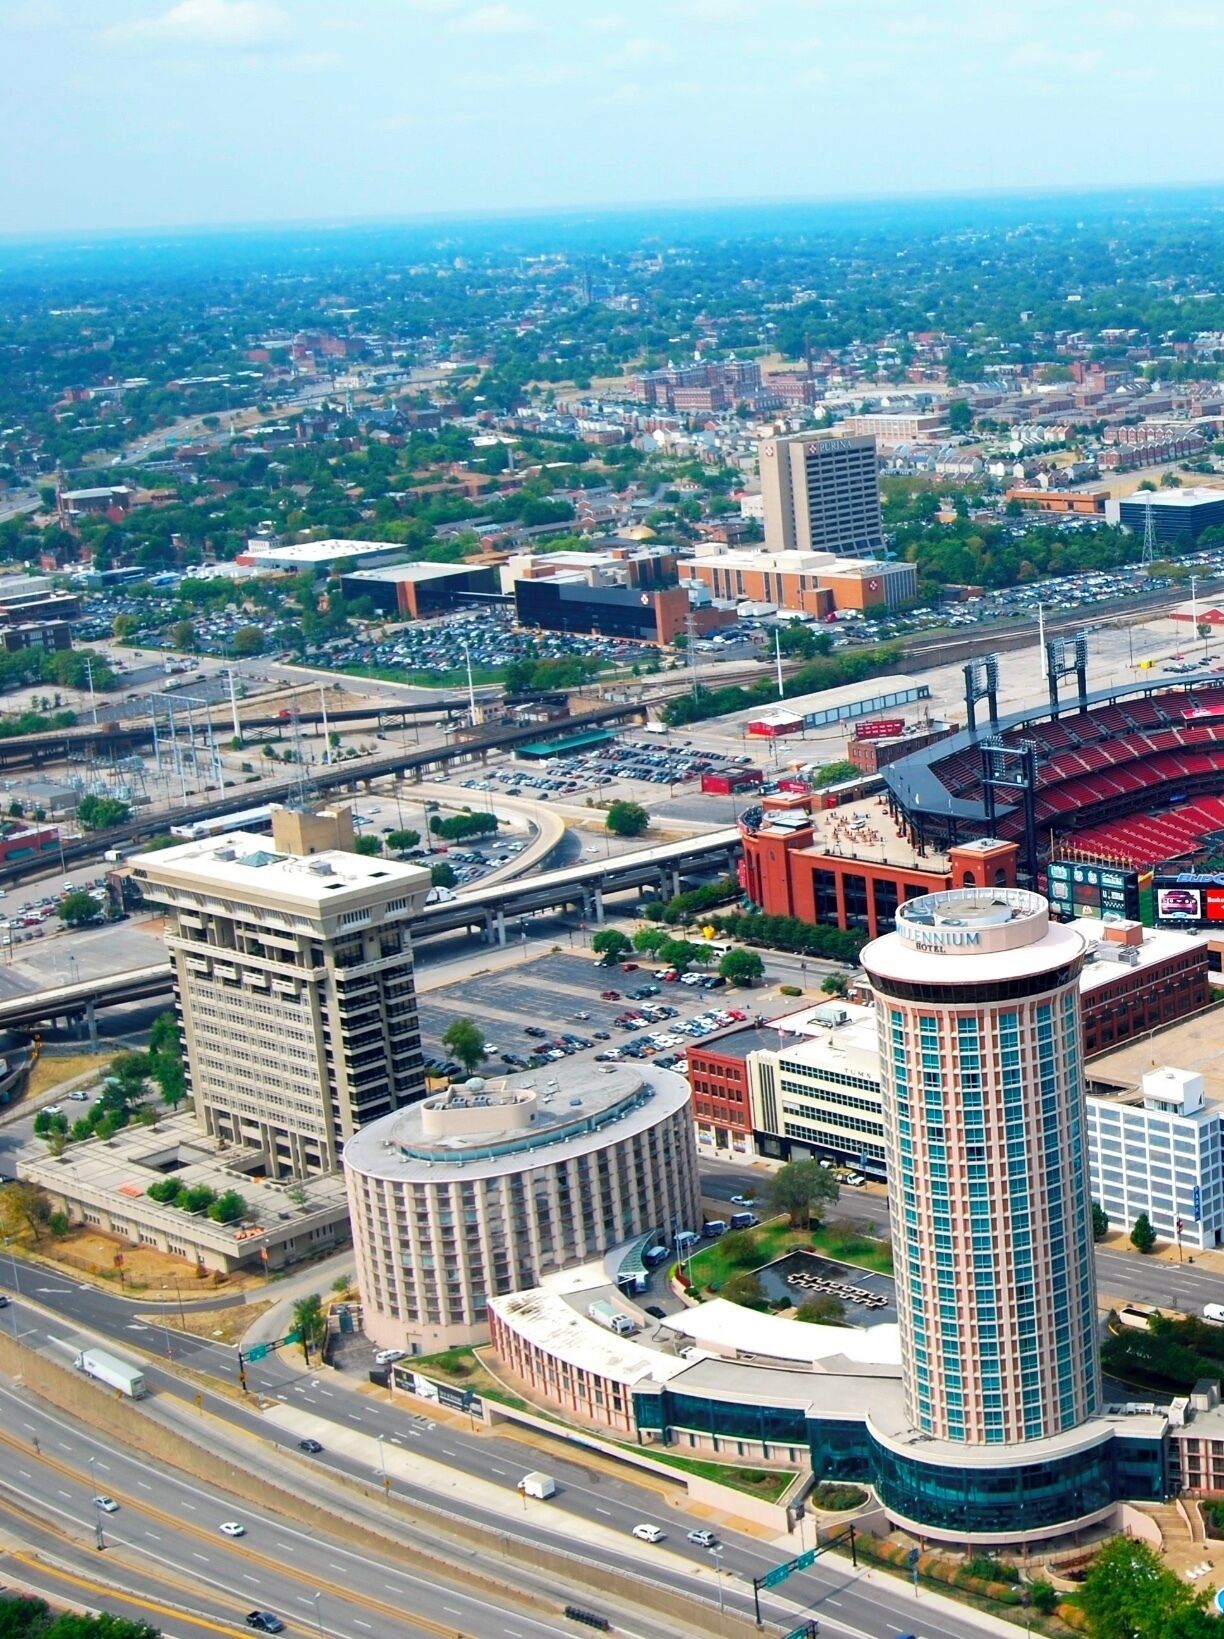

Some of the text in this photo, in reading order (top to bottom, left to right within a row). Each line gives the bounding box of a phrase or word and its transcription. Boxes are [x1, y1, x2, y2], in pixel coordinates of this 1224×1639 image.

[820, 440, 852, 452] PURINA
[916, 942, 946, 953] HOTEL
[845, 1068, 871, 1079] TUMS
